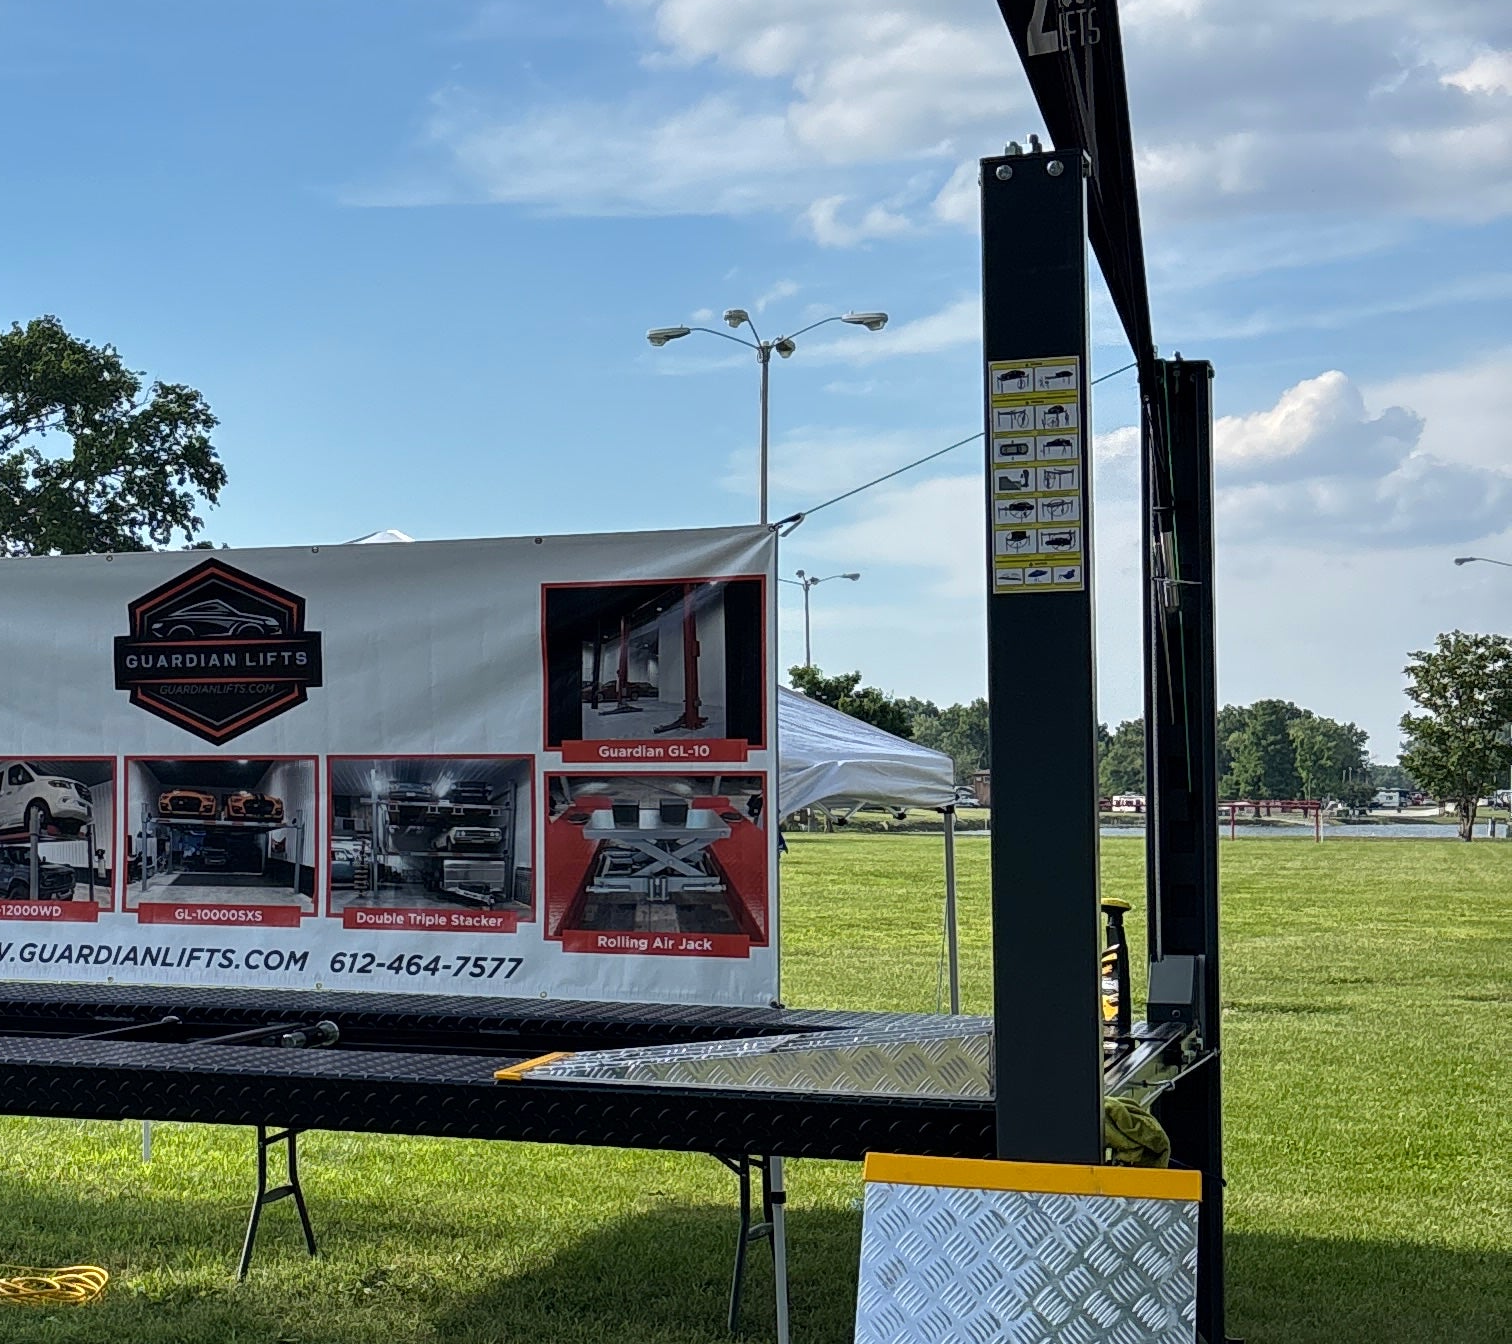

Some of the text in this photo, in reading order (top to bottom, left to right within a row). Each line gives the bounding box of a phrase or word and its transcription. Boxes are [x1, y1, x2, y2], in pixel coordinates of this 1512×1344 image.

[125, 651, 309, 669] GUARDIAN LIFTS
[159, 683, 276, 695] GUARDIANLIFTS.COM
[598, 745, 710, 758] Guardian GL-10
[174, 908, 264, 922] GL-10000SXS
[356, 912, 504, 927] Double Triple Stacker
[597, 935, 713, 951] Rolling Air Jack
[329, 951, 524, 979] 612-464-7577
